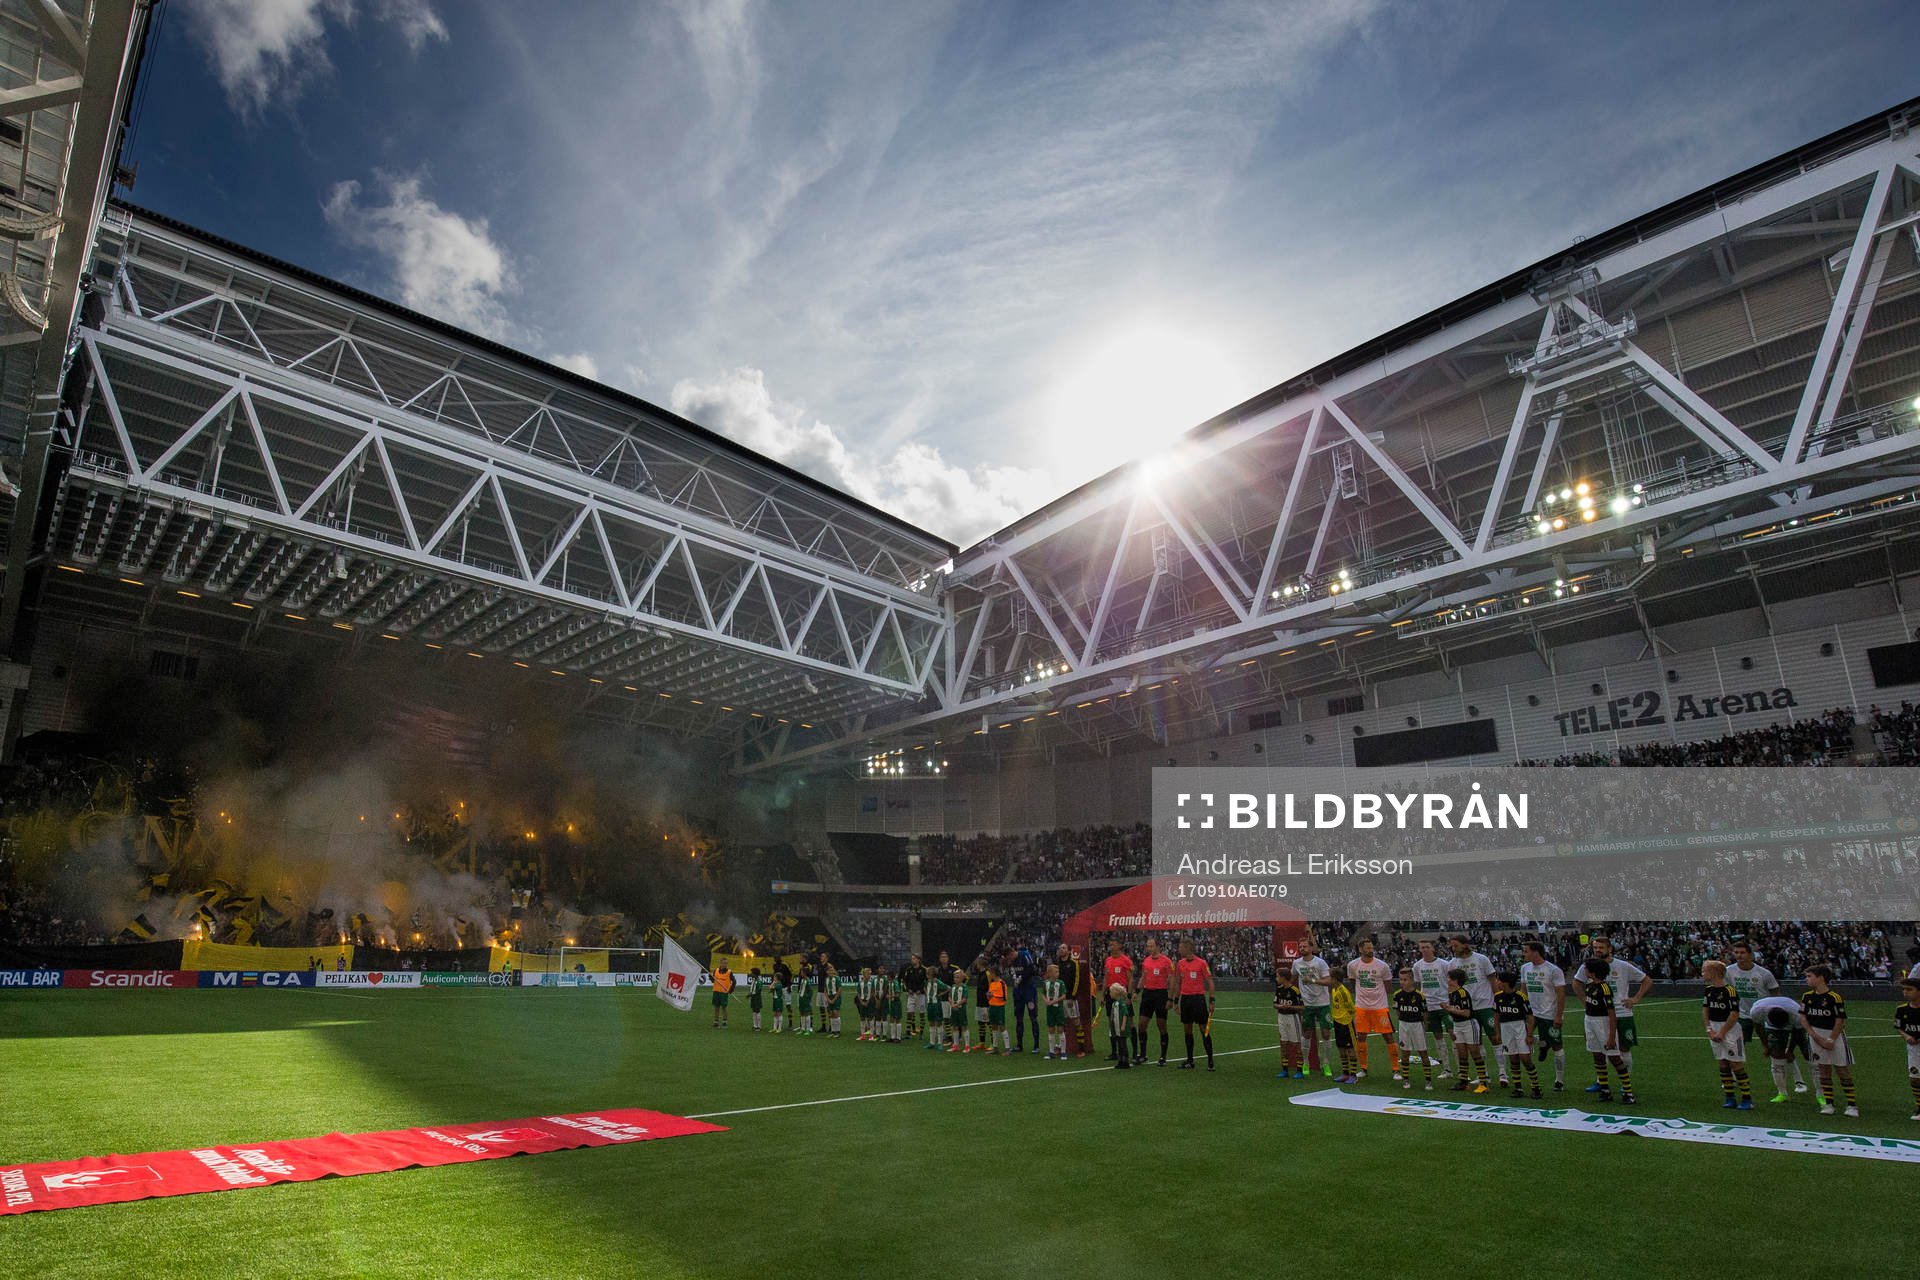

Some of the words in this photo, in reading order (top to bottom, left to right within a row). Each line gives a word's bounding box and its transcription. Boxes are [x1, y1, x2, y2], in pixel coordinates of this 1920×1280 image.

[1554, 690, 1666, 736] TELE2
[1674, 687, 1798, 722] Arena
[1576, 840, 1637, 853] HAMMARBY
[1638, 838, 1681, 849] FOTBOLL
[1687, 831, 1760, 846] GEMENSKAP
[1770, 826, 1826, 839] RESPEKT
[1108, 913, 1147, 927] Framåt
[1147, 911, 1165, 925] för
[1166, 909, 1201, 924] svensk
[1202, 908, 1248, 923] fotboll!
[32, 971, 60, 986] BAR
[90, 970, 173, 987] Scandic
[213, 972, 301, 986] MECA
[325, 974, 367, 984] PELIKAN
[382, 974, 413, 984] BAJEN
[422, 974, 488, 985] AudicomPendax
